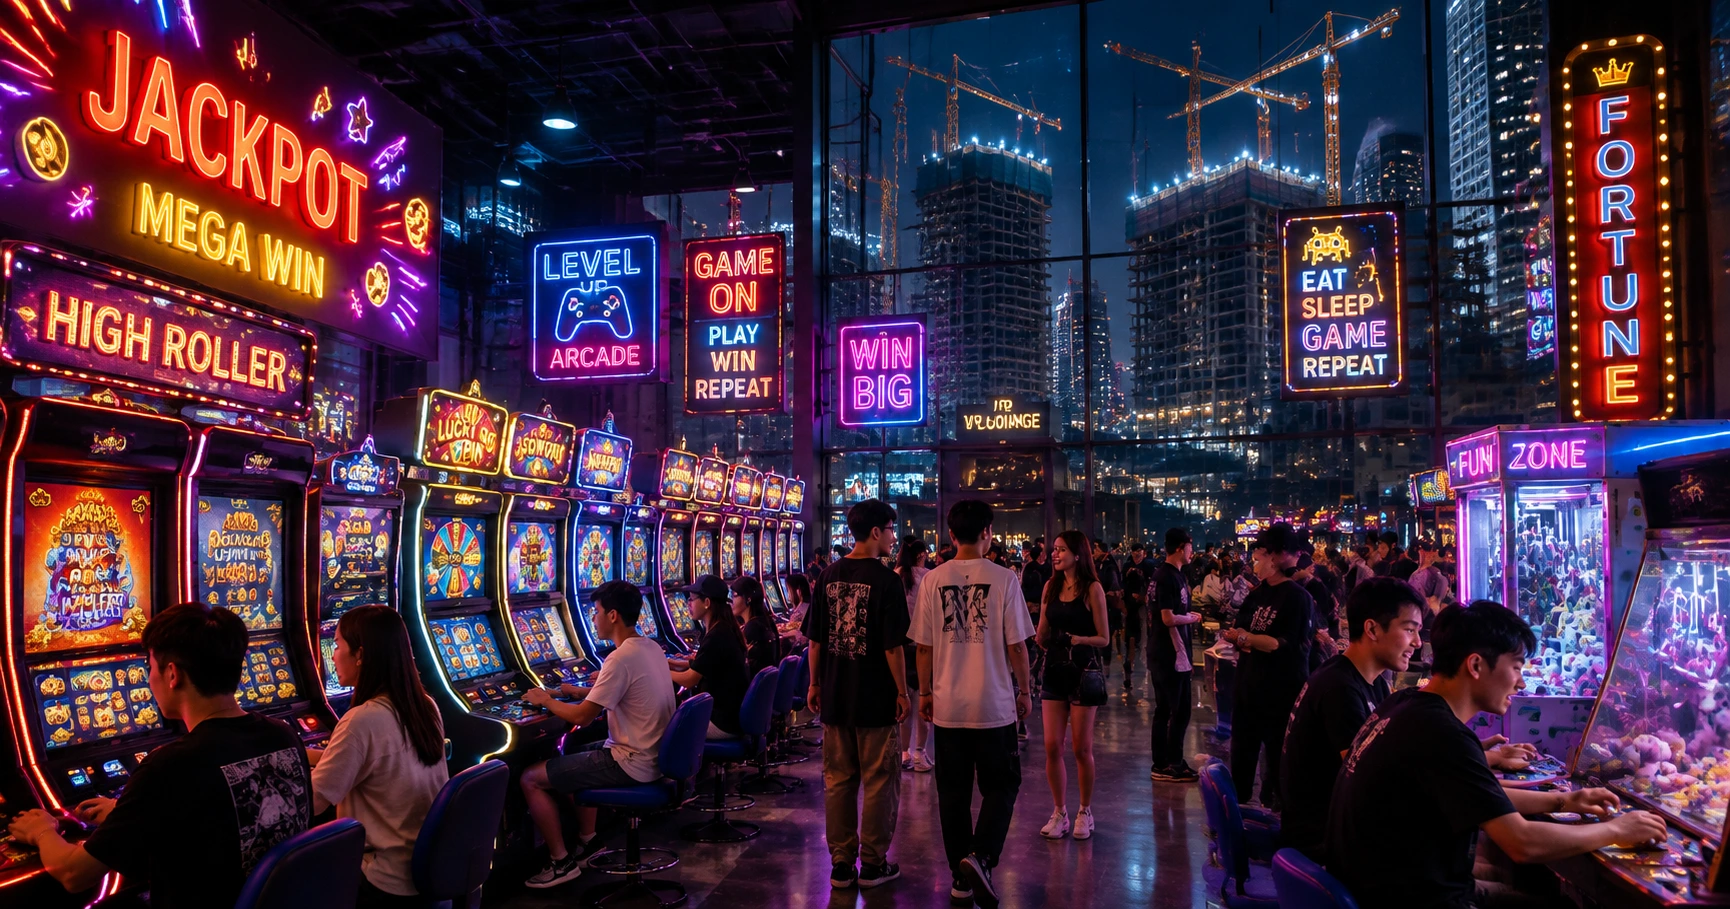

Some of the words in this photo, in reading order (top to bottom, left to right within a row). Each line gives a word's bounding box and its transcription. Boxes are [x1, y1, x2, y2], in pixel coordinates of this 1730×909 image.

[82, 30, 368, 243] JACKPOT
[133, 182, 251, 272] MEGA
[259, 233, 325, 299] WIN
[1596, 94, 1640, 405] FORTUNE
[543, 247, 641, 280] LEVEL
[694, 247, 775, 279] GAME
[1302, 268, 1347, 292] EAT
[709, 281, 757, 314] ON
[1302, 293, 1374, 319] SLEEP
[44, 290, 152, 362] HIGH
[162, 322, 287, 393] ROLLER
[708, 323, 760, 346] PLAY
[1302, 320, 1387, 351] GAME
[549, 345, 640, 369] ARCADE
[710, 350, 756, 372] WIN
[849, 336, 913, 371] WIN
[1303, 354, 1388, 378] REPEAT
[695, 377, 772, 400] REPEAT
[852, 374, 913, 410] BIG
[1459, 444, 1493, 478] FUN
[1509, 439, 1587, 470] ZONE
